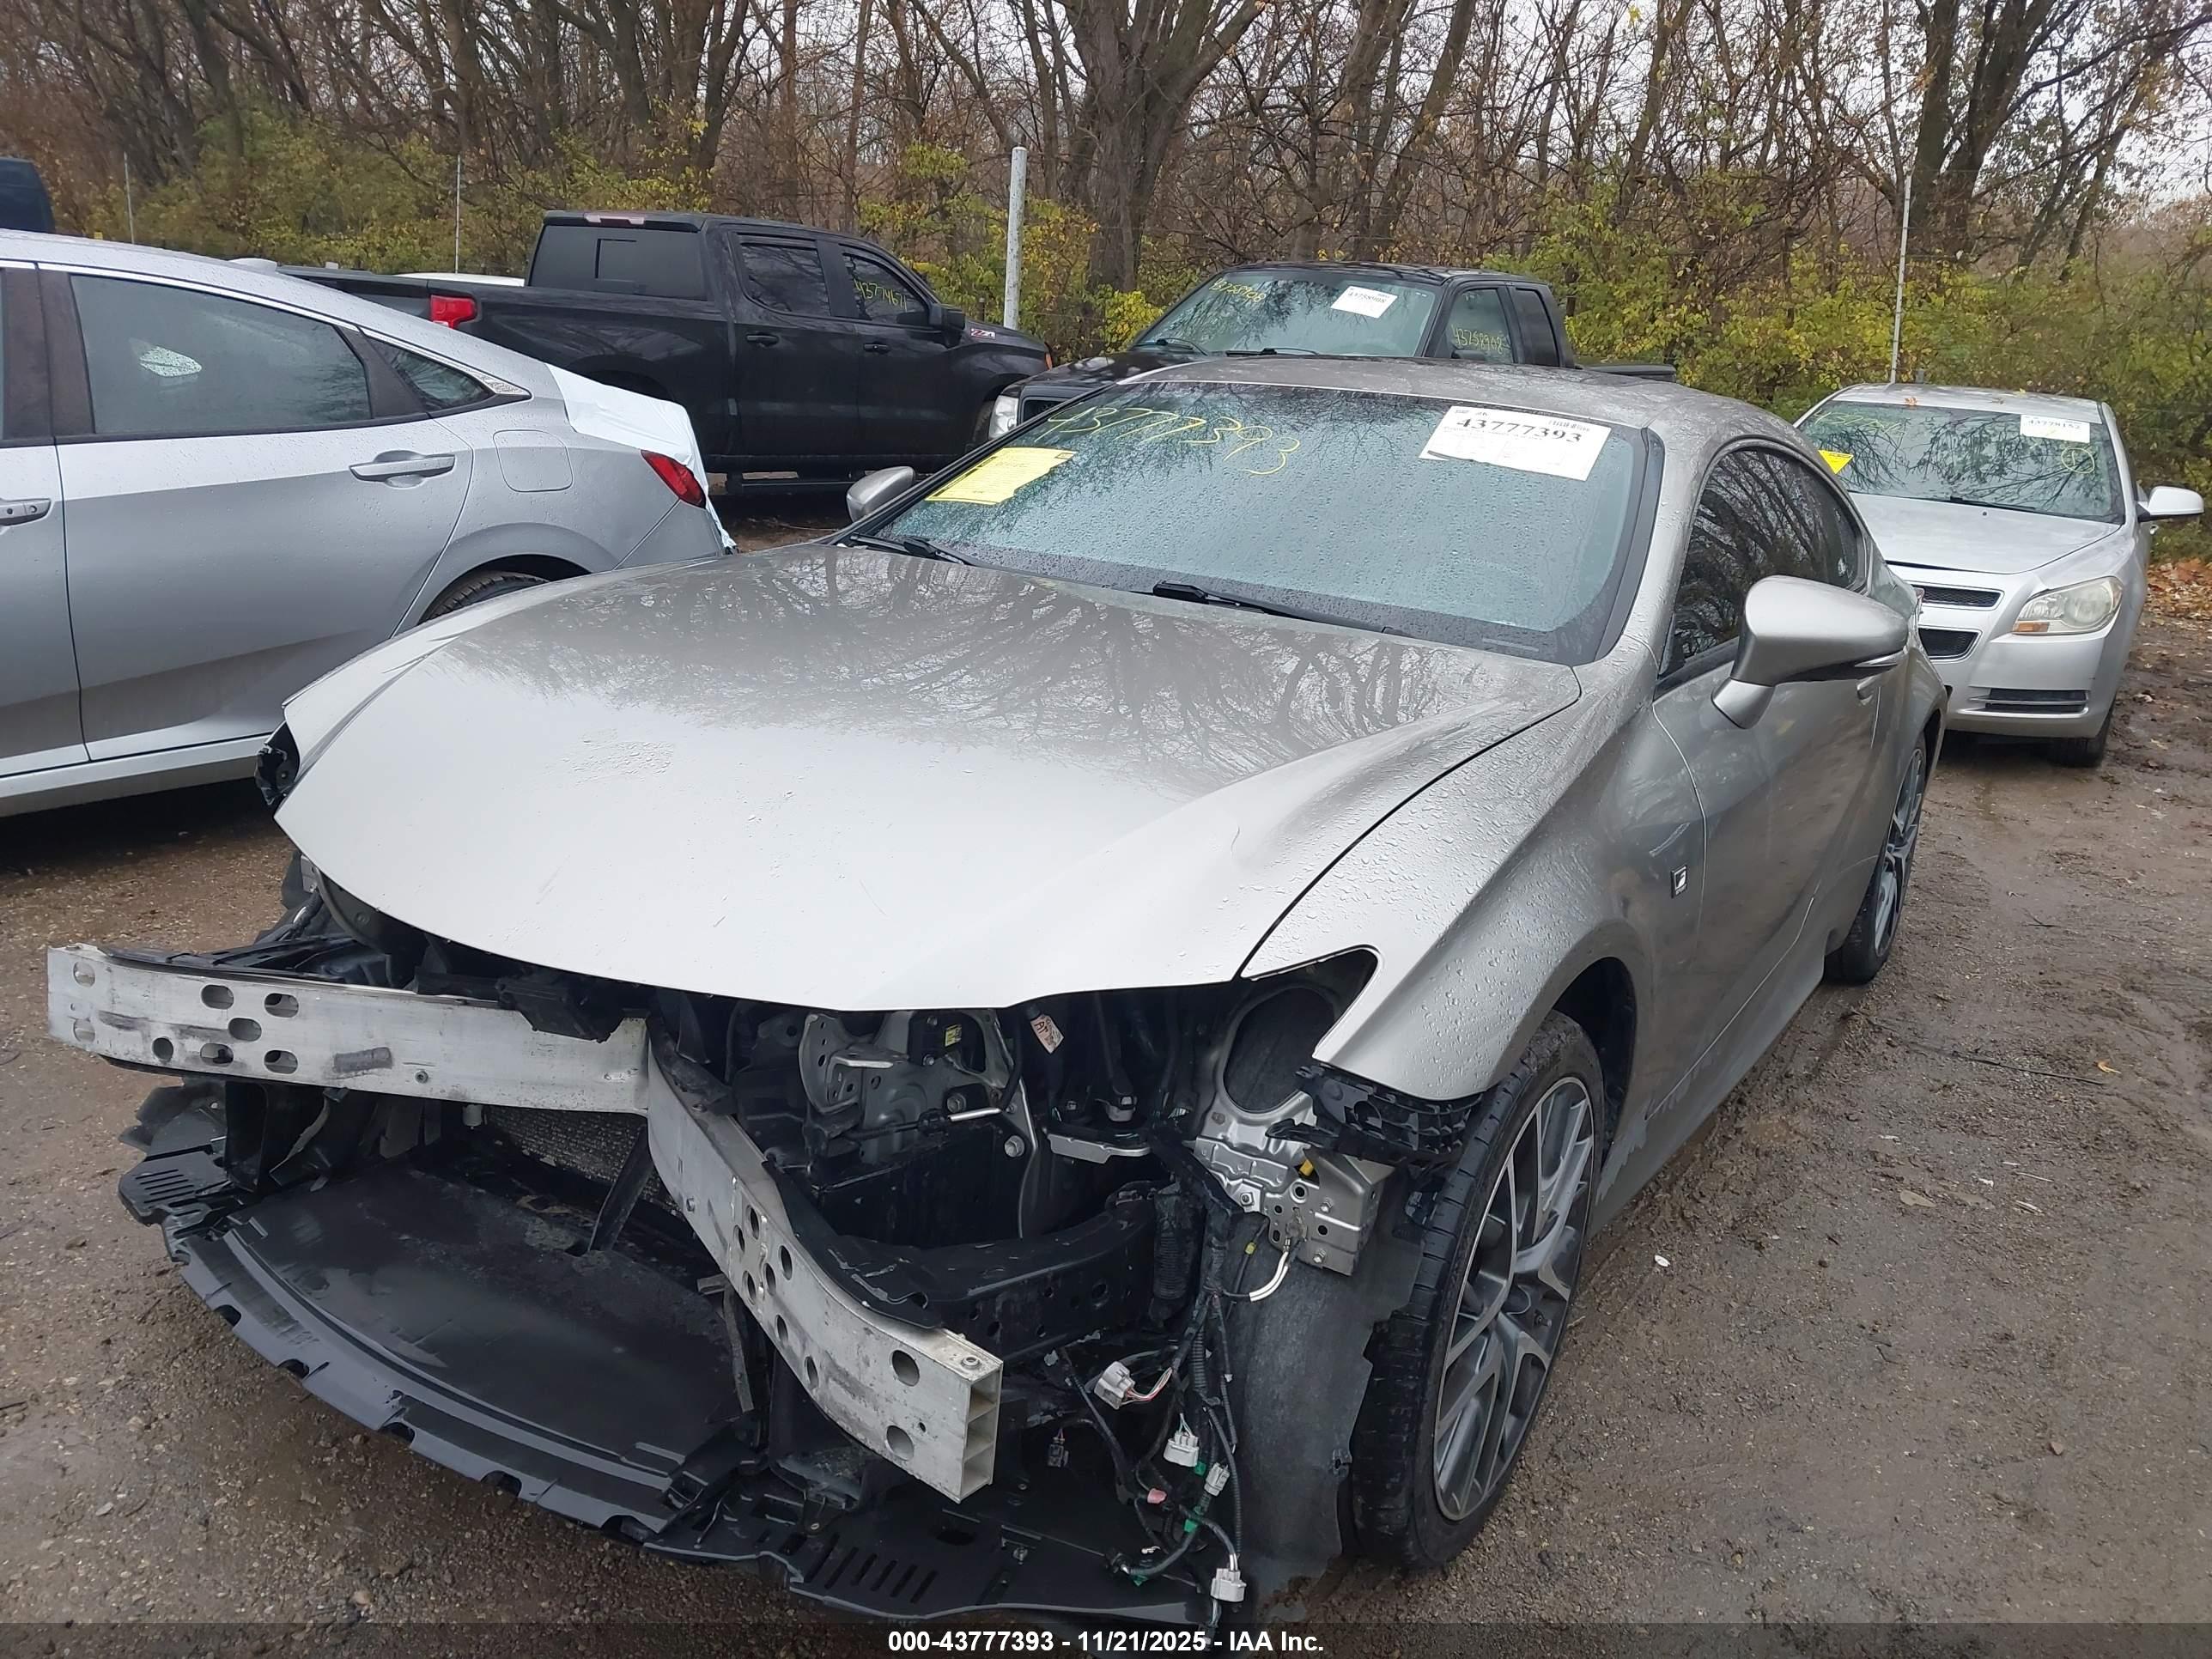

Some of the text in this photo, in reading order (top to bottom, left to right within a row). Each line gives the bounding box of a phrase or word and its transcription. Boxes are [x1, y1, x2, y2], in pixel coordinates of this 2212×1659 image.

[854, 278, 908, 313] 43774671
[1034, 405, 1300, 475] 43777393
[1455, 418, 1583, 443] 43777393
